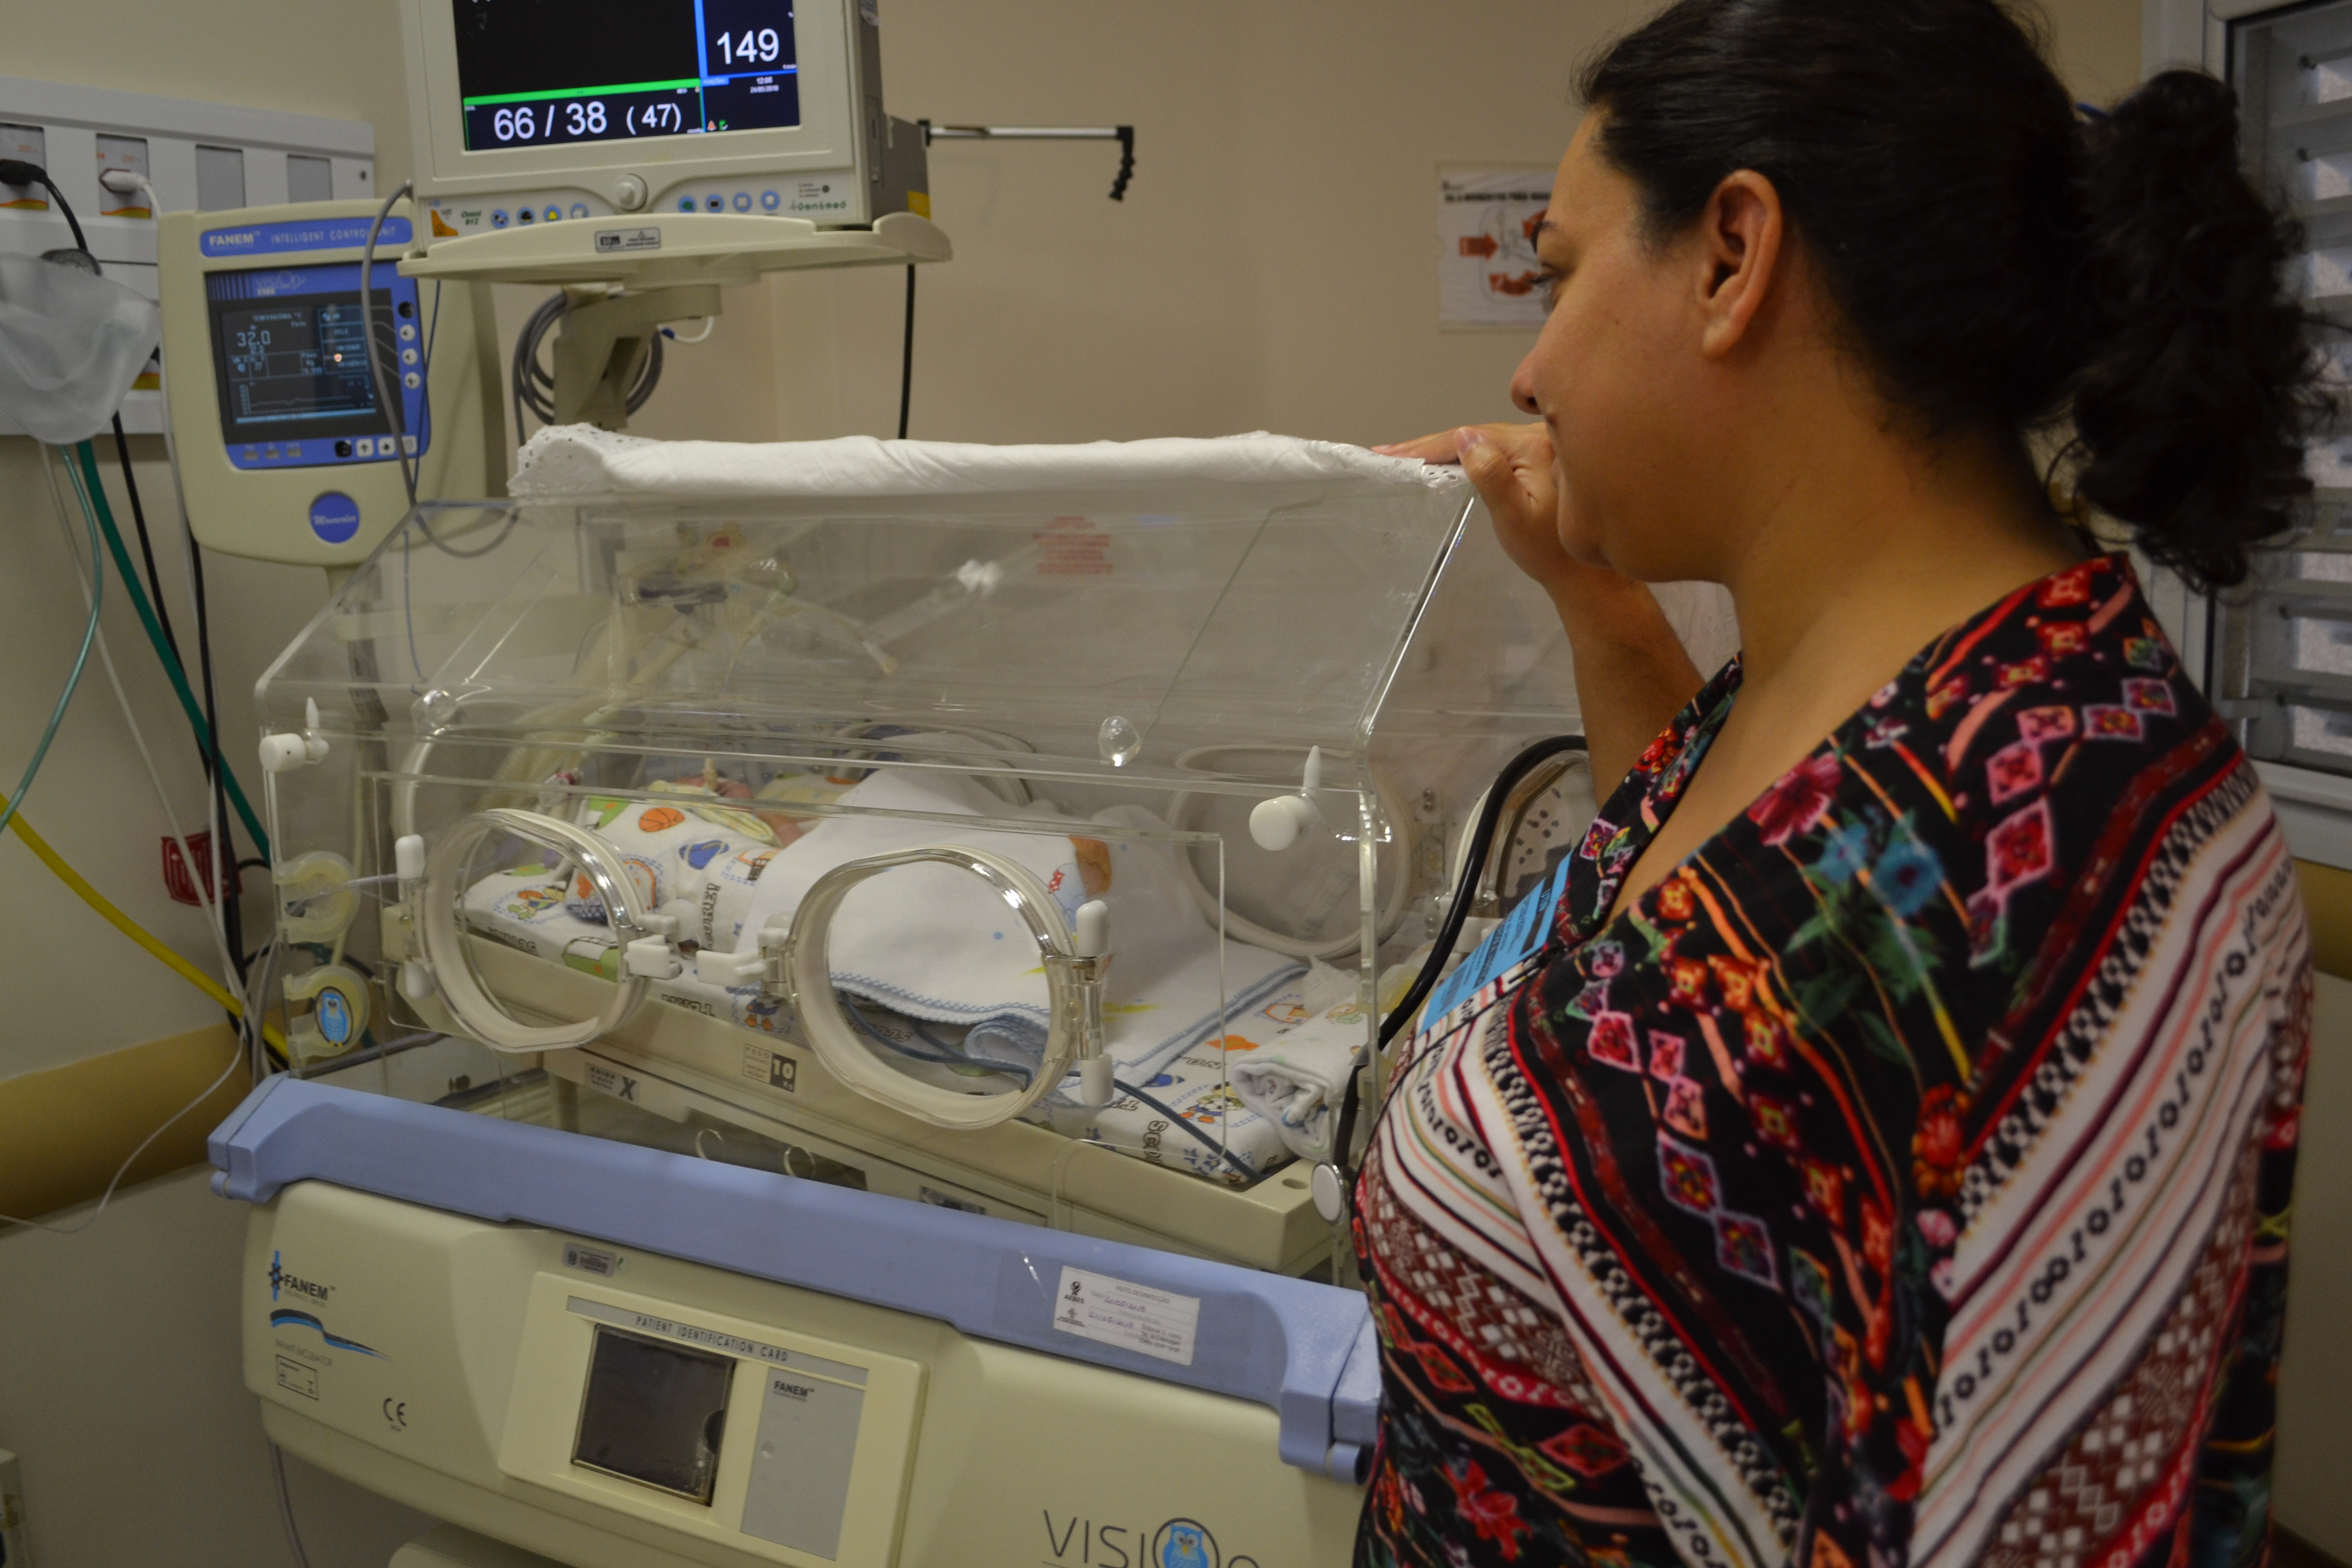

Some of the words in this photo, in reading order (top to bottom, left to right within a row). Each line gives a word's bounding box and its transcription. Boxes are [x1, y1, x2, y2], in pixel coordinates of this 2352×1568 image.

[717, 28, 779, 65] 149
[494, 107, 536, 141] 66
[545, 105, 555, 137] /
[566, 101, 607, 135] 38
[209, 233, 254, 247] FANEM
[271, 231, 324, 244] INTELLIGENT
[236, 329, 271, 348] 32.0
[773, 1058, 794, 1080] 10
[619, 1076, 637, 1100] X
[284, 1273, 328, 1301] FANEM
[635, 1315, 672, 1334] PATIENT
[677, 1326, 754, 1354] IDENTIFICATION
[760, 1346, 789, 1362] CARD
[773, 1380, 809, 1398] FANEM
[383, 1397, 407, 1427] CE
[1042, 1509, 1260, 1568] VISIO
